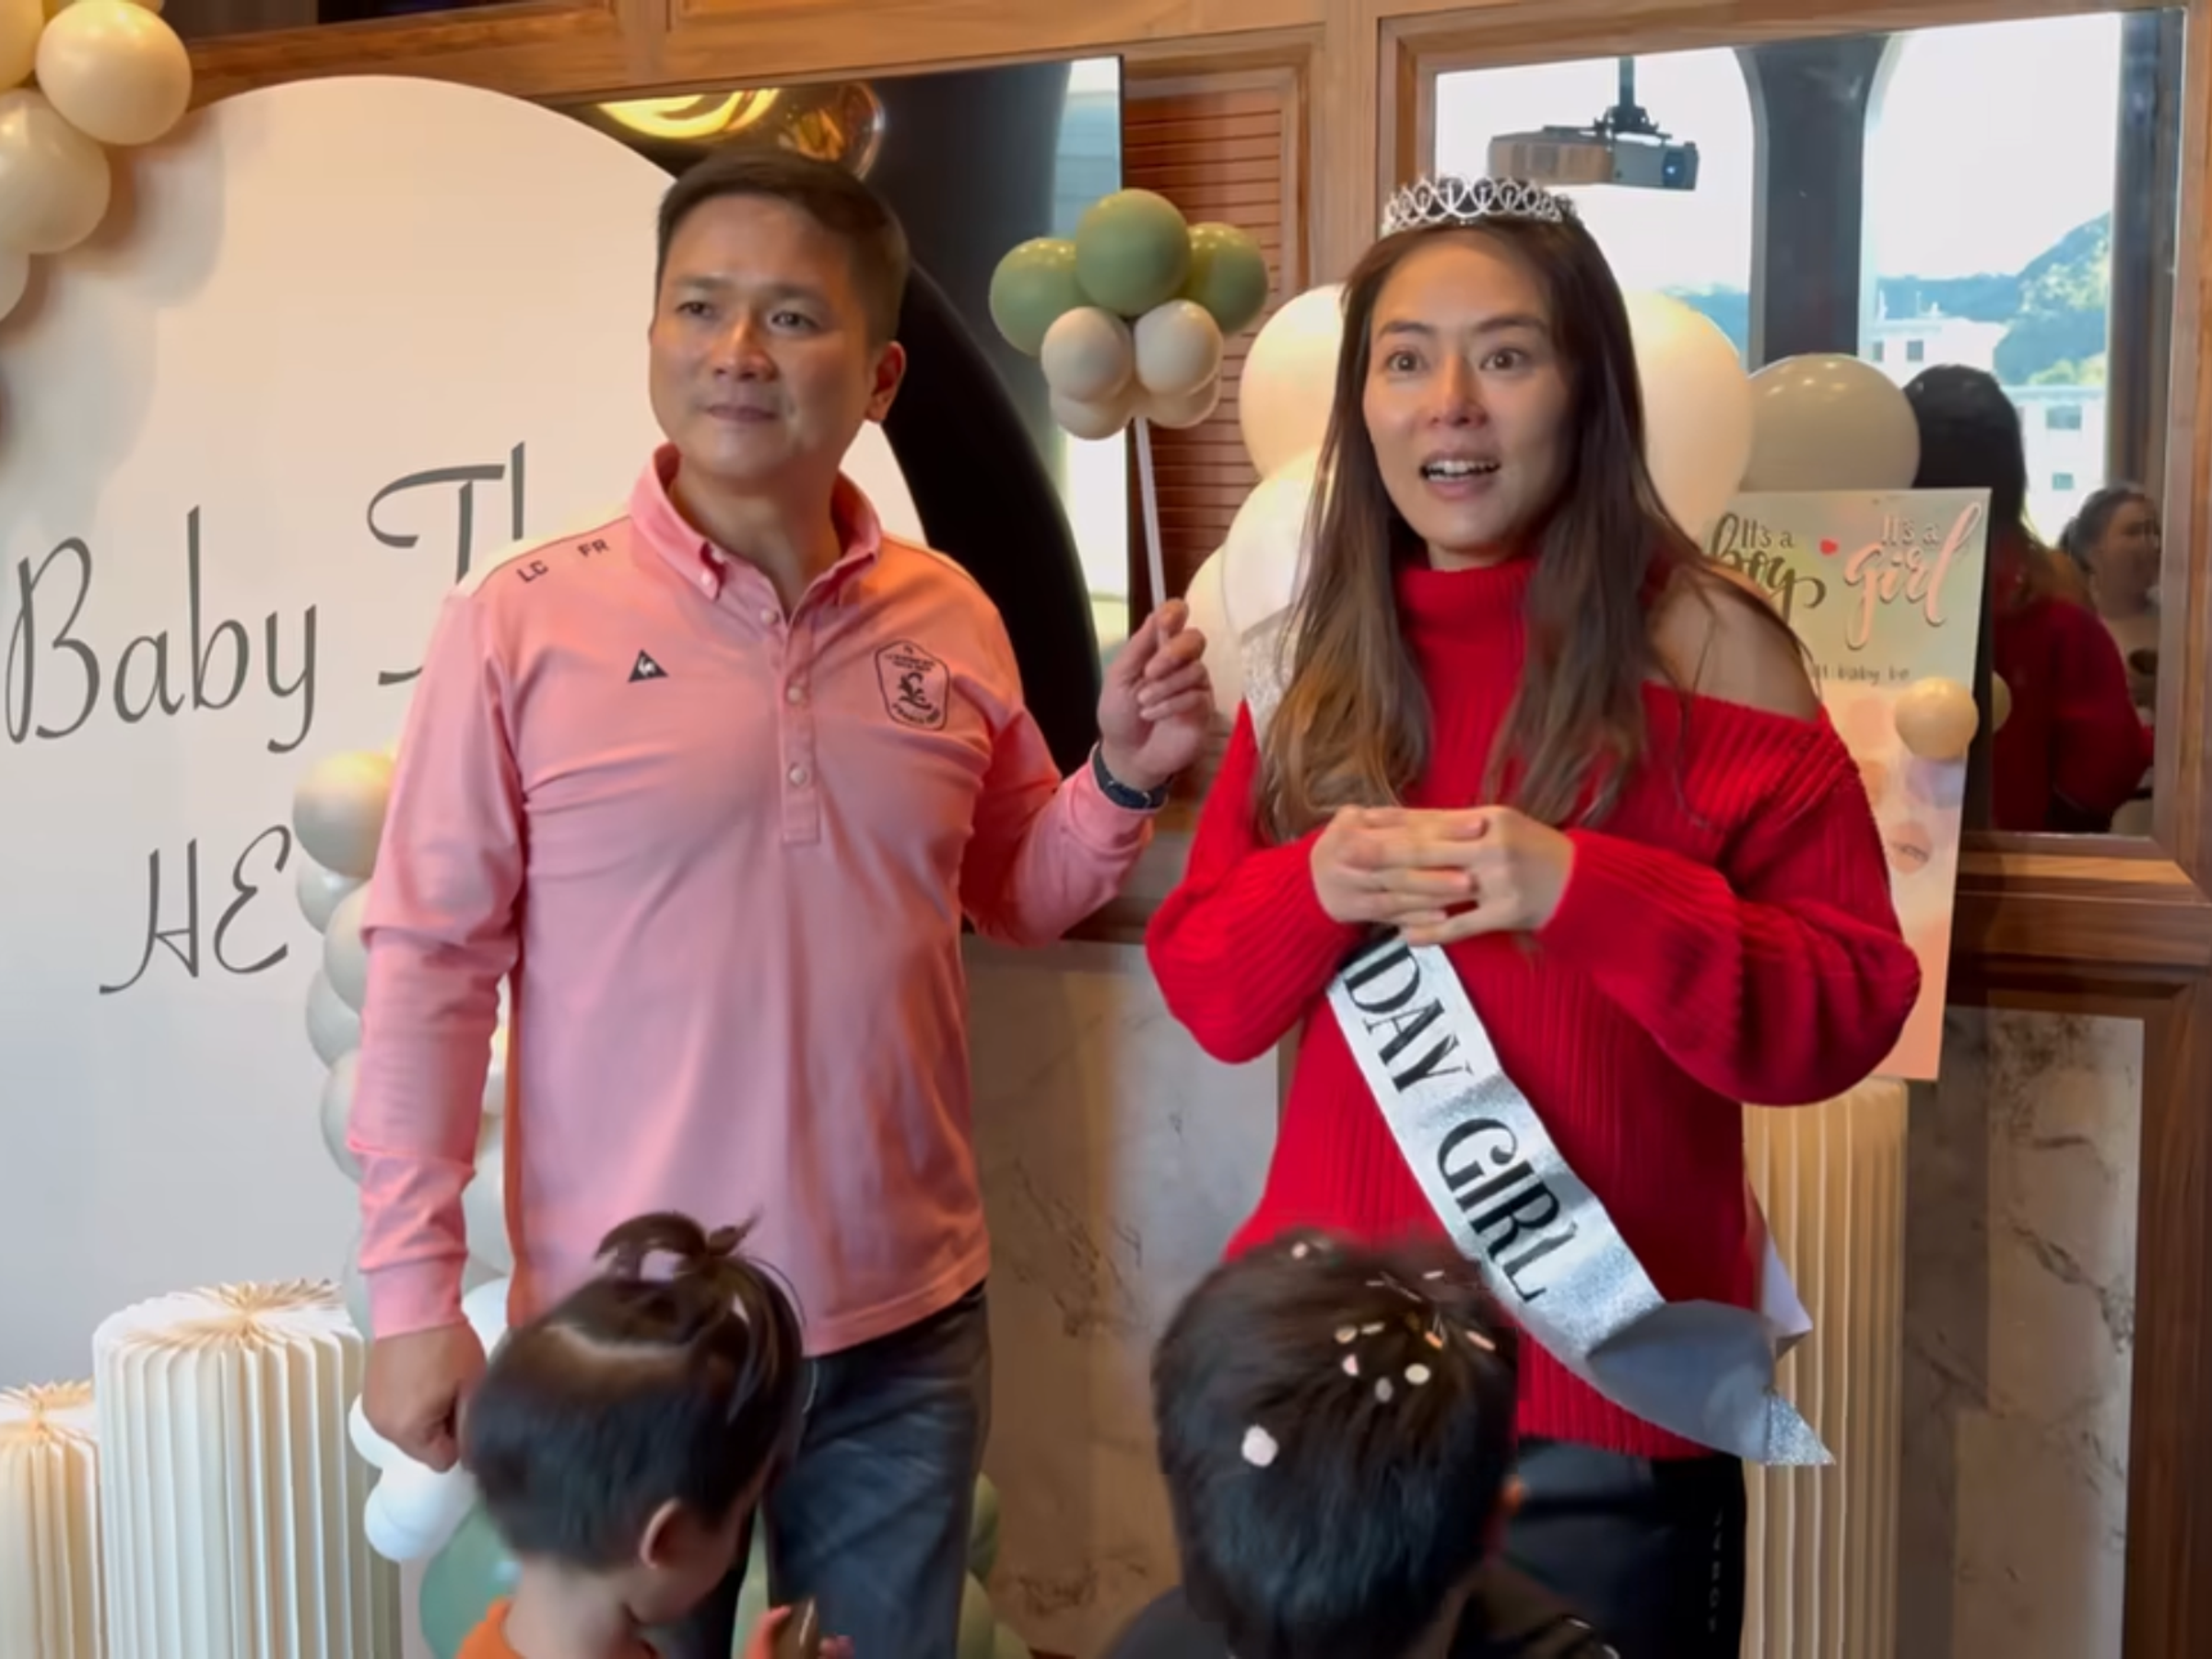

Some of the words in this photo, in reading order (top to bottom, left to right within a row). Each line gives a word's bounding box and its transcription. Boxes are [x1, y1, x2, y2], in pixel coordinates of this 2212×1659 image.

[577, 537, 610, 558] FR
[1779, 530, 1795, 550] a
[1923, 524, 1940, 547] a
[516, 559, 550, 583] LC
[1843, 501, 1983, 652] girl
[6, 503, 317, 754] Baby
[1837, 663, 1881, 688] baby
[99, 824, 292, 995] HE
[1342, 944, 1475, 1094] DAY
[1436, 1117, 1579, 1304] GIRL
